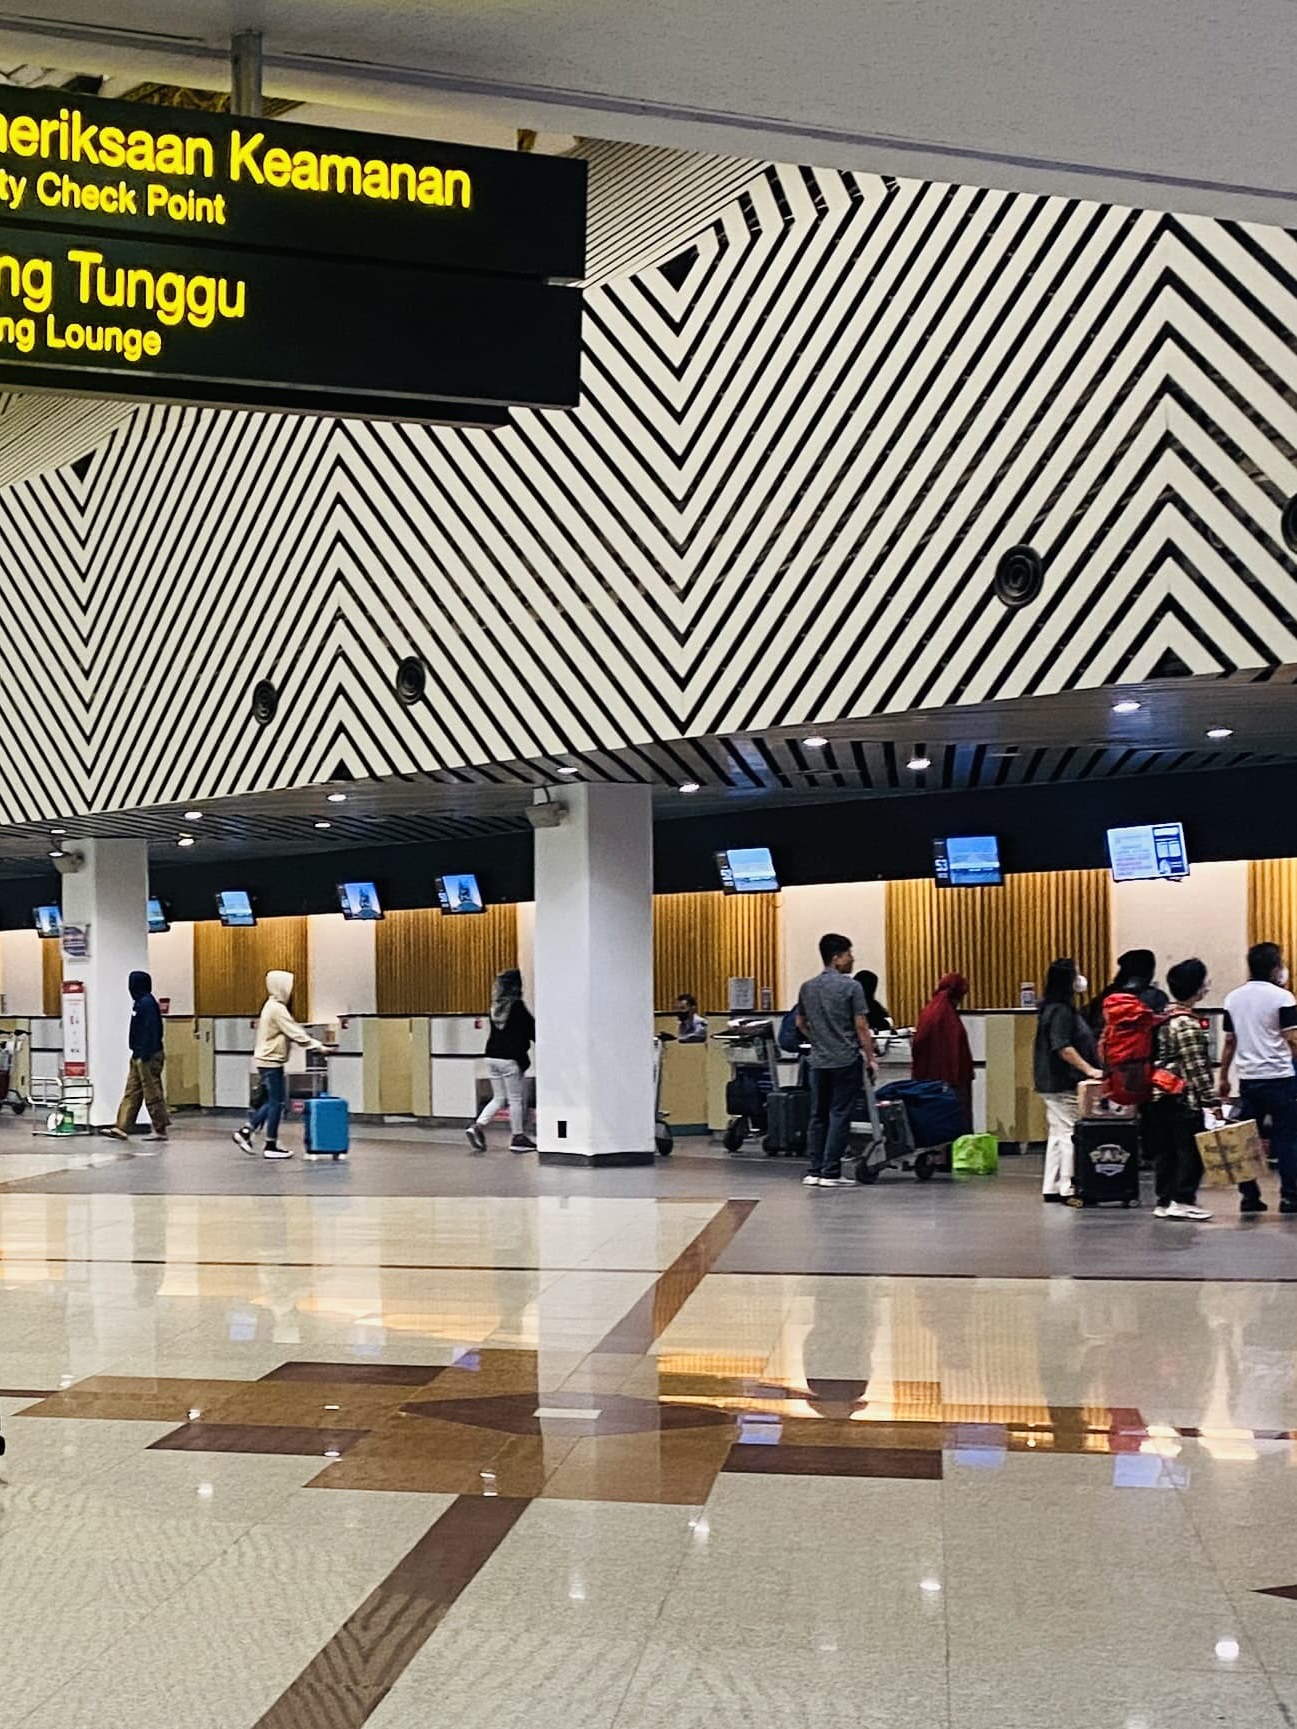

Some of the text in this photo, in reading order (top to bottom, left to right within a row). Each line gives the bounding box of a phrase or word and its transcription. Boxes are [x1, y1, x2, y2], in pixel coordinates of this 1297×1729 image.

[36, 170, 137, 214] Check
[147, 184, 226, 225] Point
[229, 129, 472, 209] Keamanan
[67, 249, 246, 328] Tunggu
[46, 313, 162, 362] Lounge
